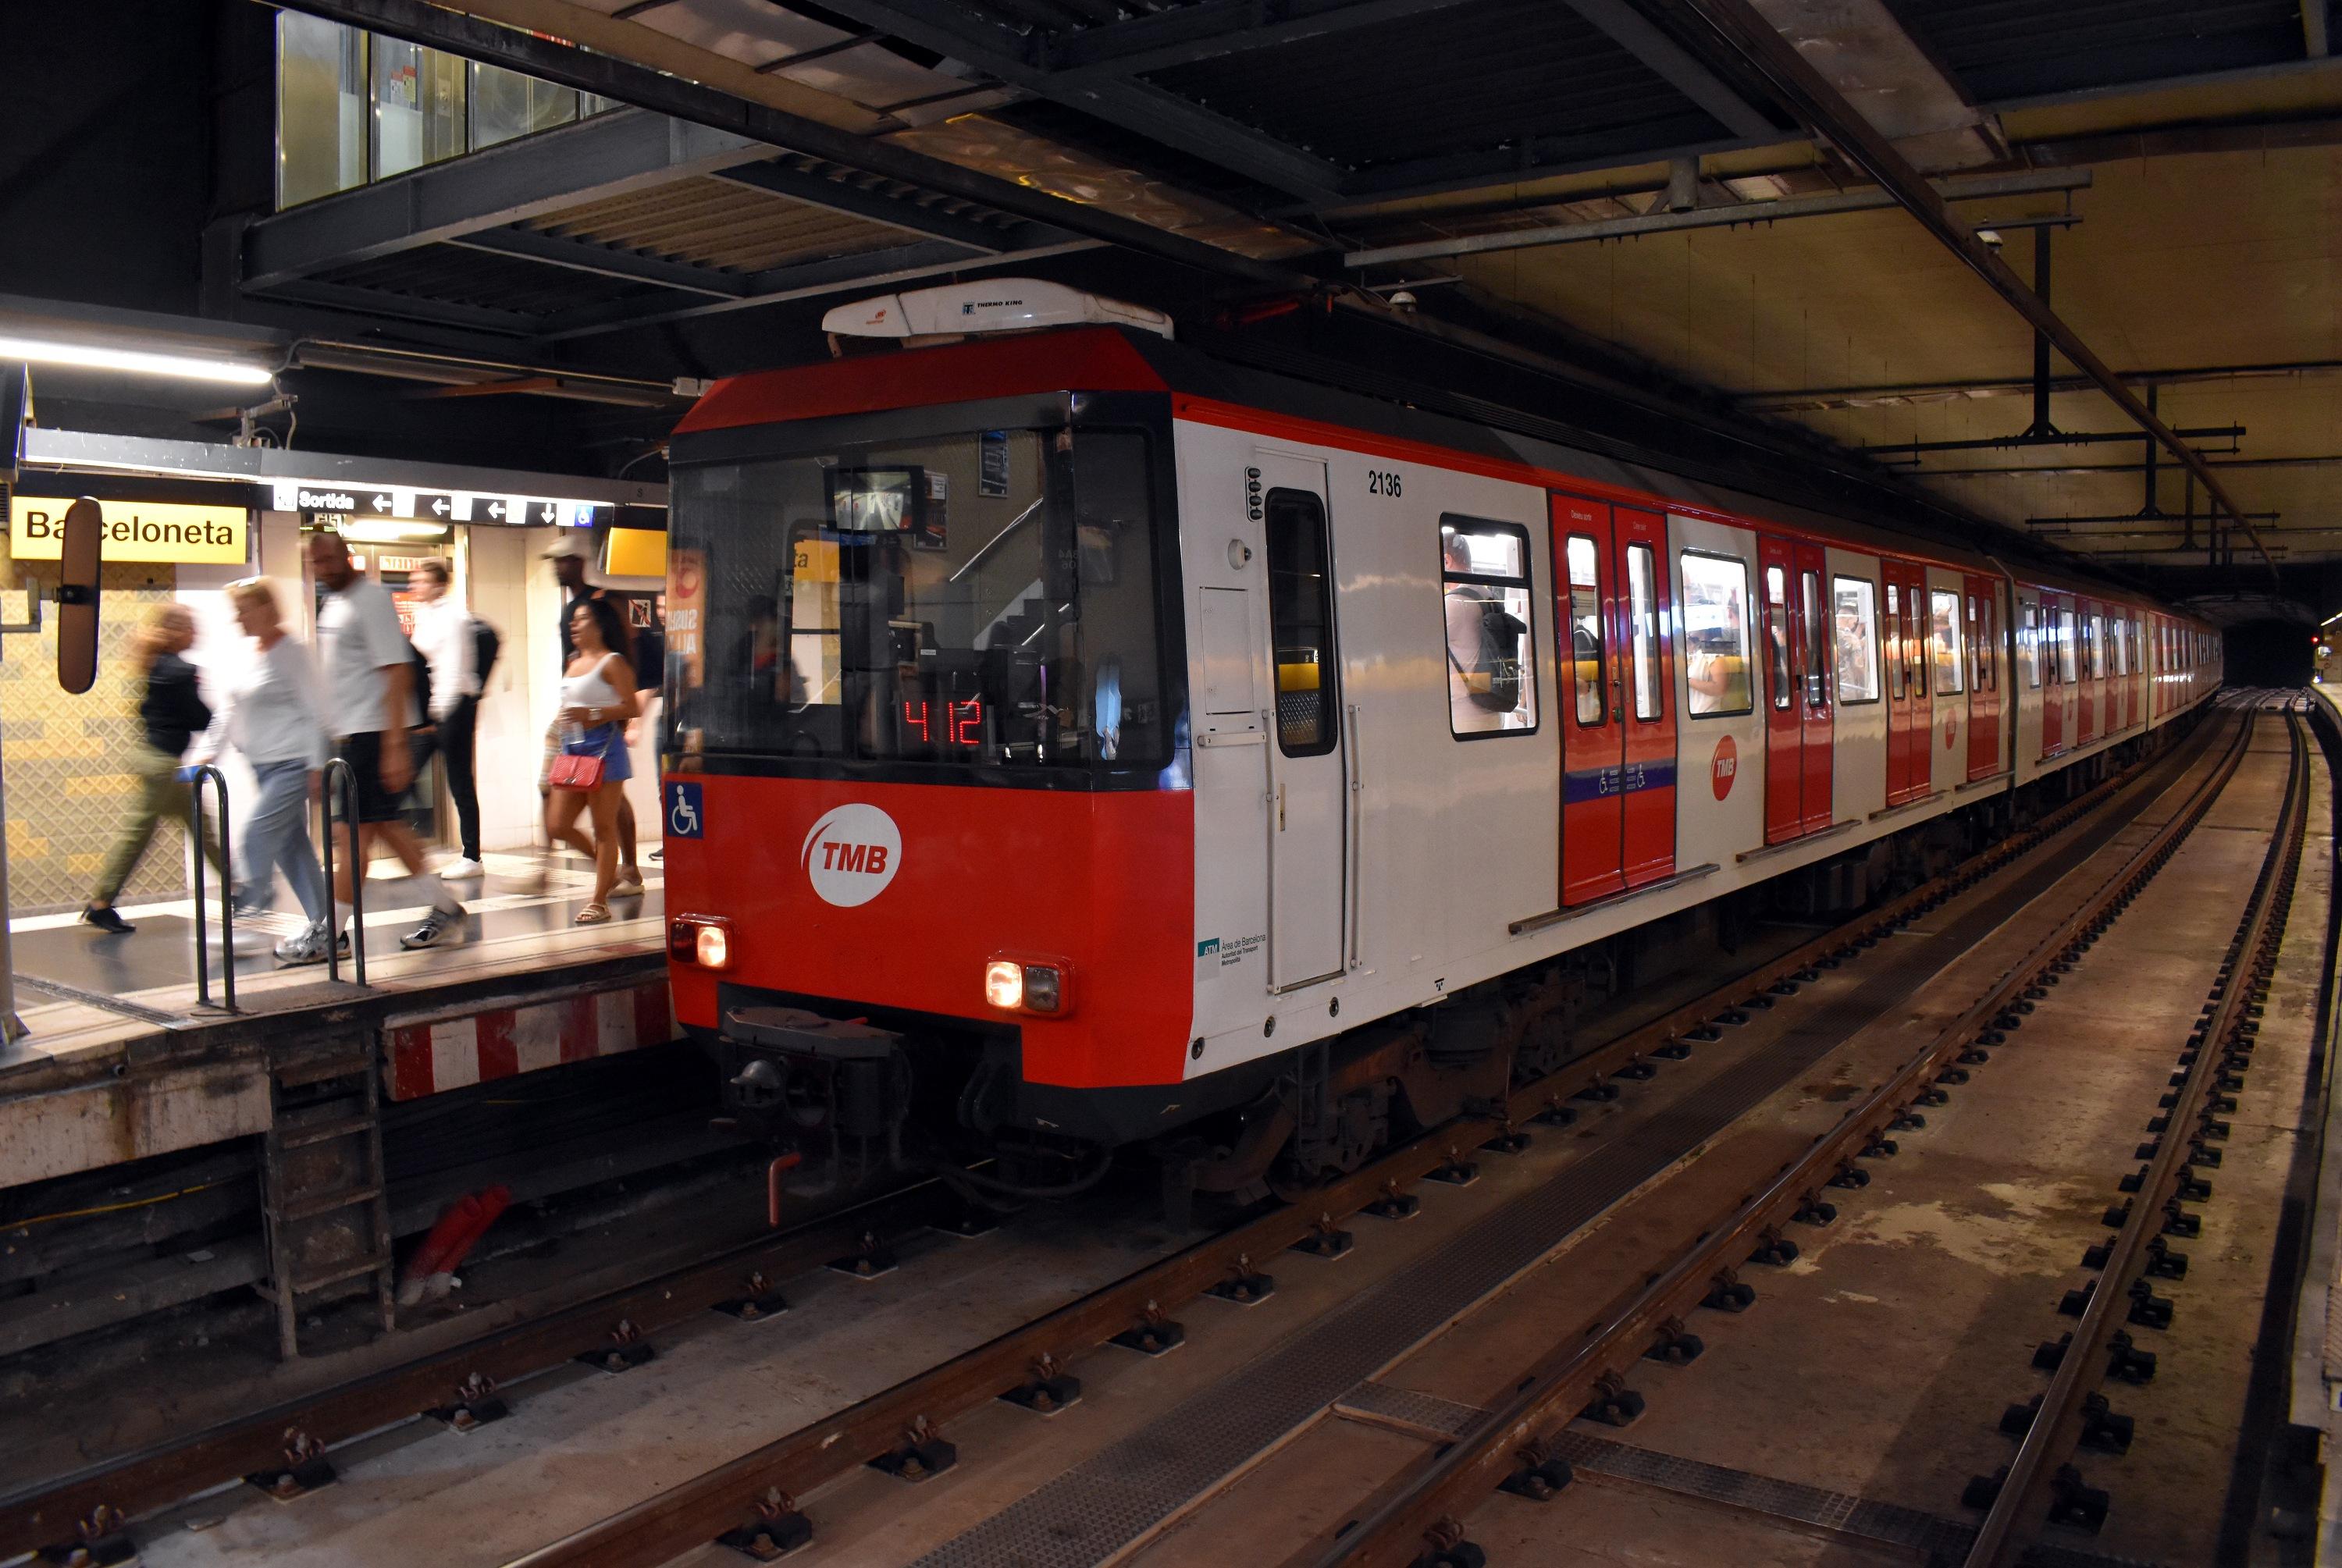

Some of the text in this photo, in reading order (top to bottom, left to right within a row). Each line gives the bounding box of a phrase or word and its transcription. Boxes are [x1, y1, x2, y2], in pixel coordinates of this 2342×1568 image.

[1369, 470, 1402, 498] 2136
[299, 490, 354, 510] Sortida
[27, 510, 233, 545] Baeloneta
[1717, 758, 1734, 778] TMB
[823, 841, 888, 874] TMB
[1205, 944, 1217, 956] ATM
[1234, 939, 1241, 948] de
[1242, 934, 1266, 946] Barcelona
[1242, 945, 1258, 954] Transport
